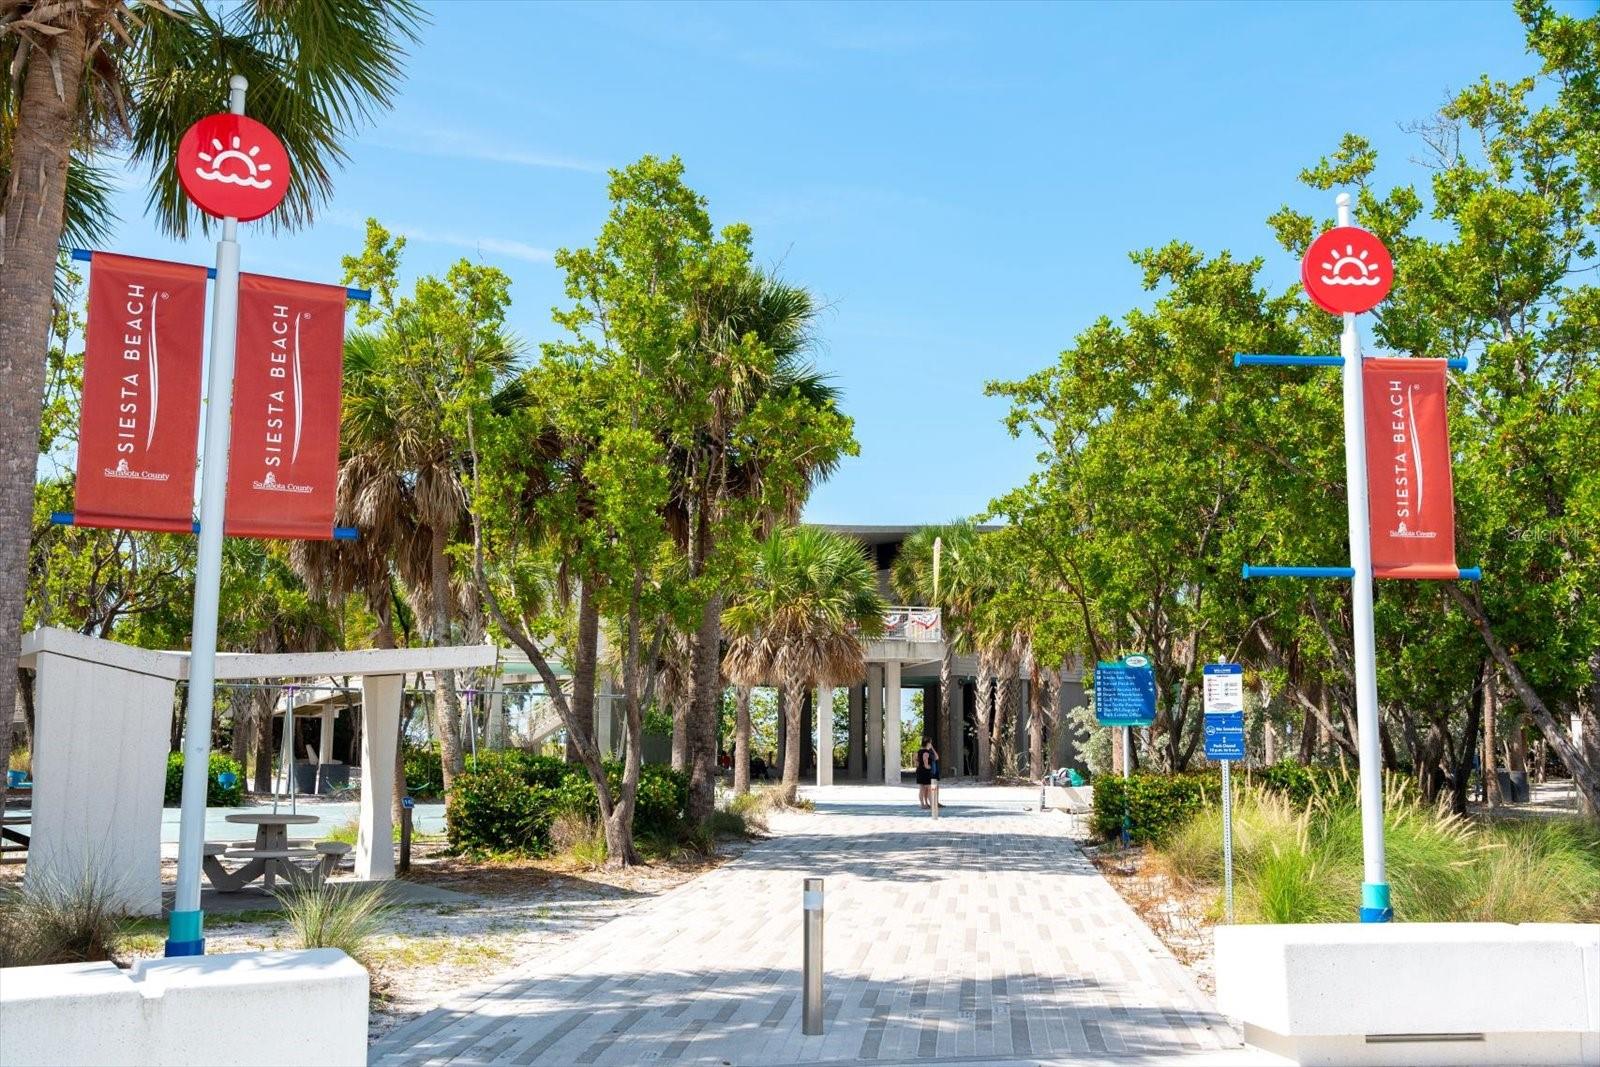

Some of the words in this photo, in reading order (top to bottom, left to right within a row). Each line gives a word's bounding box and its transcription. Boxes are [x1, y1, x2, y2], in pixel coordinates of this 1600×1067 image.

[123, 284, 145, 361] BEACH
[270, 304, 289, 378] BEACH
[117, 373, 139, 454] SIESTA
[265, 390, 285, 467] SIESTA
[1389, 380, 1406, 443] BEACH
[104, 467, 140, 478] Sarasota
[141, 470, 170, 481] County
[287, 482, 314, 493] County
[1395, 453, 1410, 518] SIESTA
